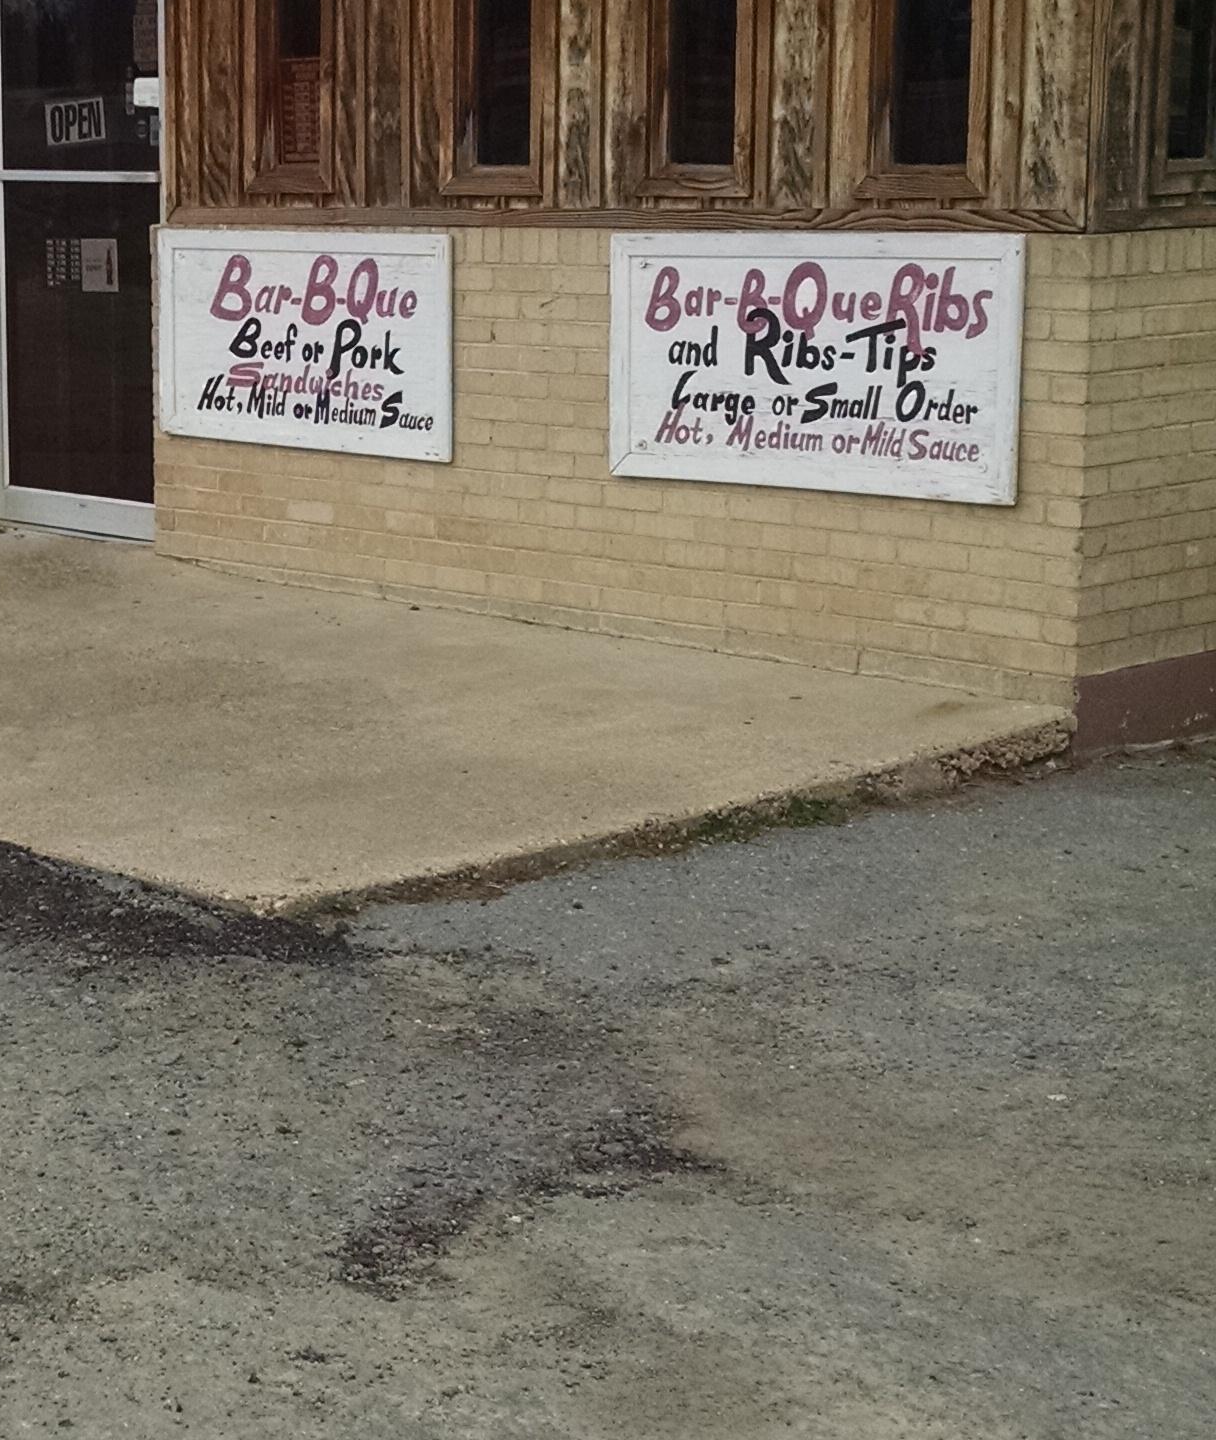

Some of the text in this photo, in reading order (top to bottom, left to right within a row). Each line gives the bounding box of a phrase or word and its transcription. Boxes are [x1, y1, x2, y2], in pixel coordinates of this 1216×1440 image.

[50, 100, 101, 143] OPEN
[209, 254, 418, 325] Bar-B-Que
[644, 261, 993, 358] Bar-B-Que Ribs
[229, 317, 405, 379] Beef or Pork
[668, 307, 936, 389] and Ribs-Tips
[197, 374, 434, 431] Hot, Mild or Medium Sauce
[225, 361, 385, 401] Sandwiches
[672, 370, 979, 425] Large or Small Order
[655, 409, 980, 462] Hot, Medium or Mild Sauce
